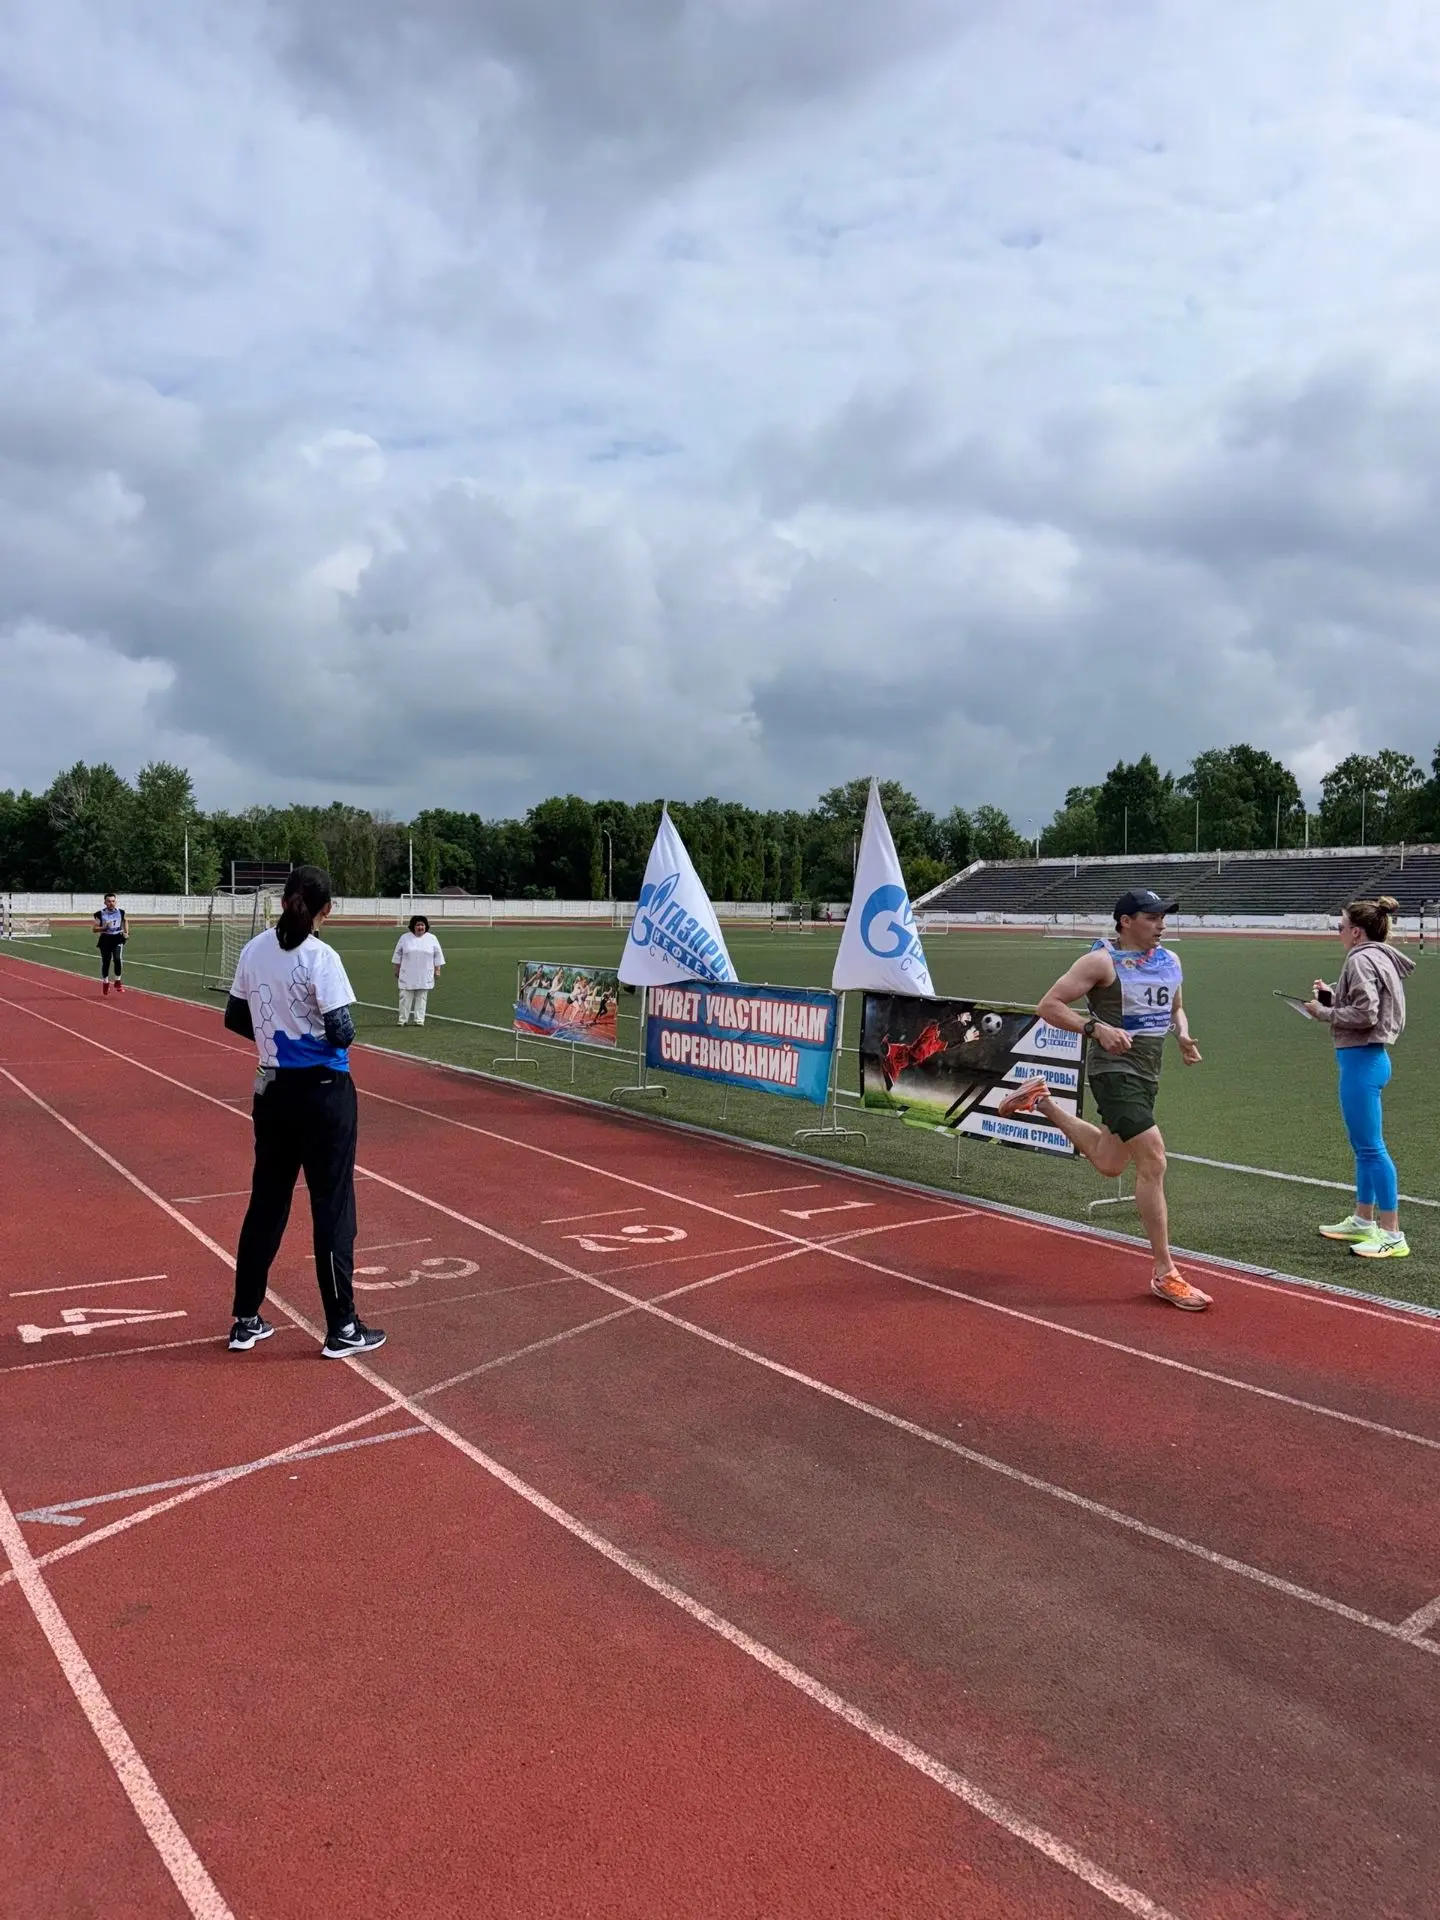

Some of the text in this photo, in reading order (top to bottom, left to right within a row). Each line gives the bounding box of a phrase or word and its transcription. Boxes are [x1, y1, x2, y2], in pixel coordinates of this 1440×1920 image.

[1144, 986, 1169, 1007] 16
[706, 994, 827, 1042] УЧАСТНИКАМ
[661, 1030, 799, 1086] СОРЕВНОВАНИЙ!
[981, 1119, 996, 1133] МЫ
[561, 1225, 688, 1252] 2
[353, 1257, 480, 1290] 3
[17, 1308, 188, 1343] 4
